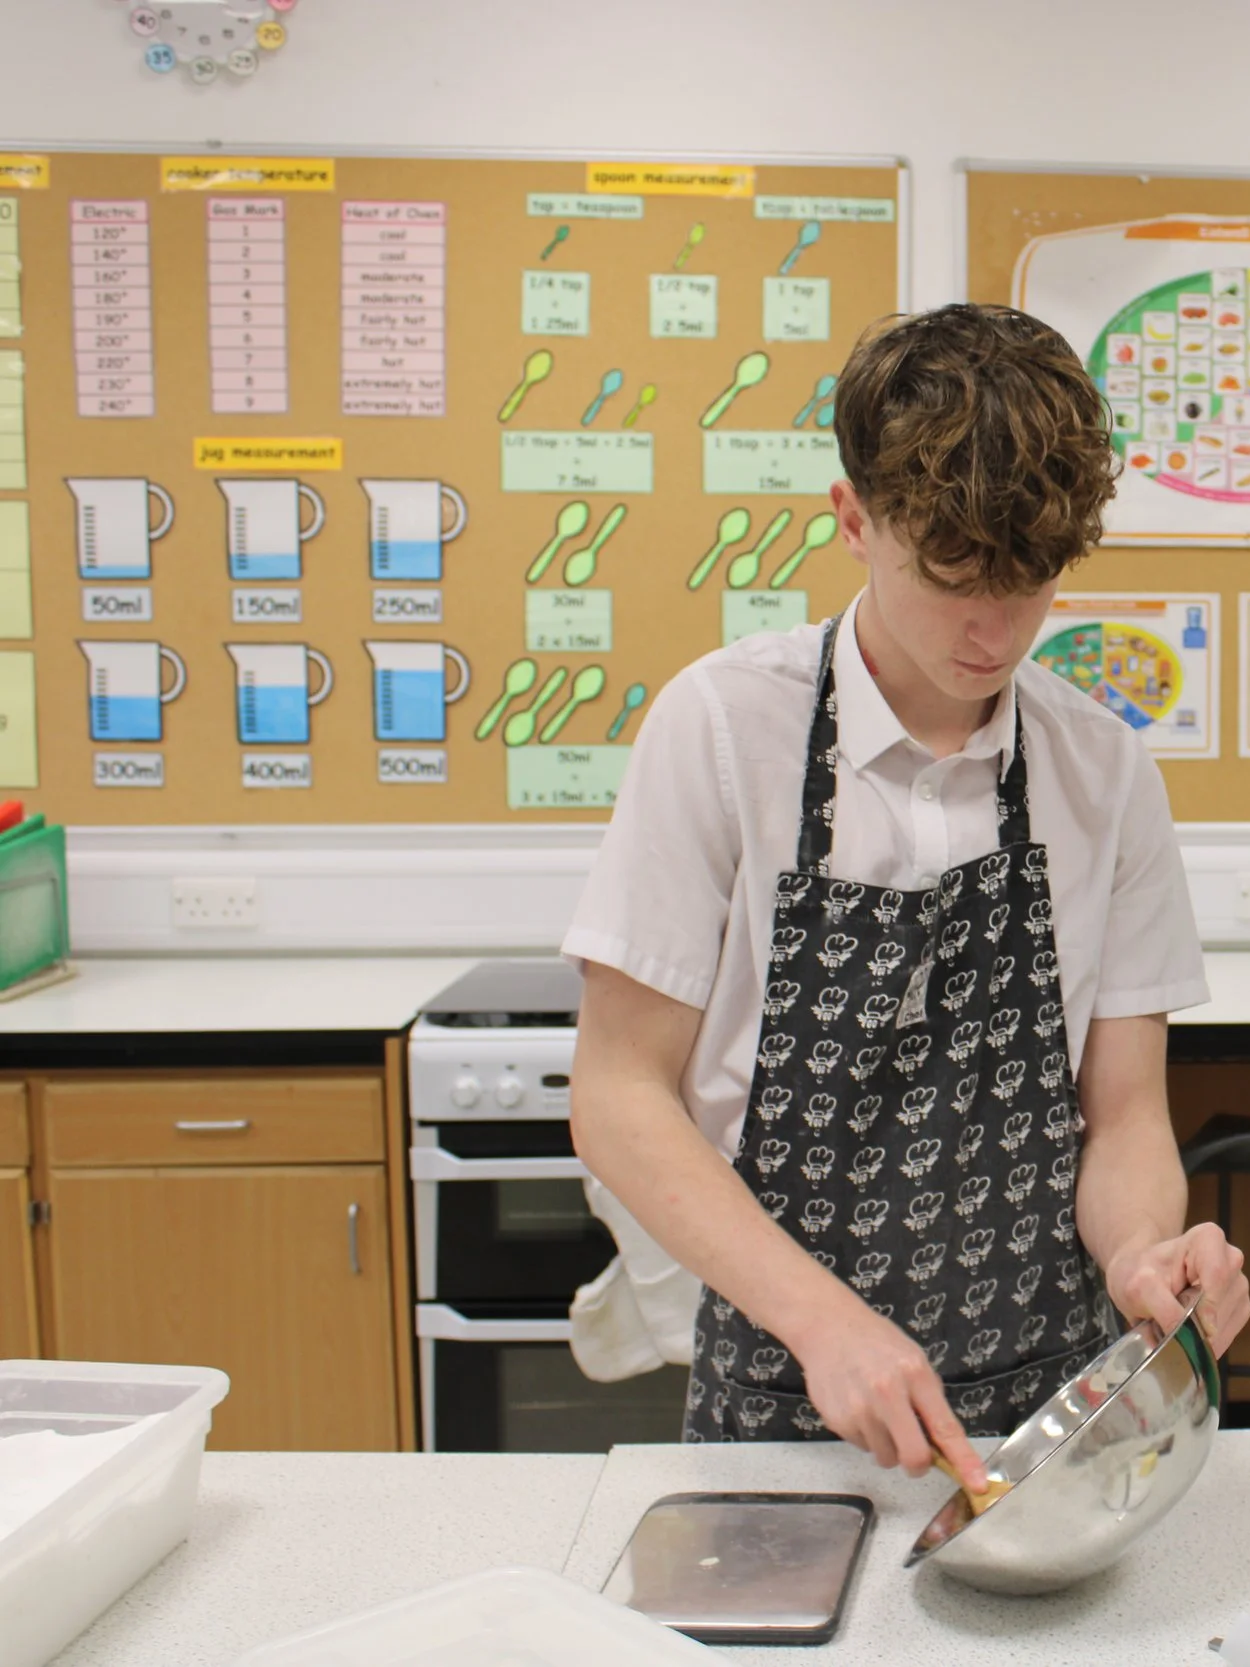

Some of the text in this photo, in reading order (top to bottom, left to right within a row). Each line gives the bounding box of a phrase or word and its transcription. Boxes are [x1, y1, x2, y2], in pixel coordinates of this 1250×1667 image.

[152, 50, 172, 65] 35
[593, 171, 635, 186] spoon
[82, 205, 136, 218] Electric
[199, 444, 336, 463] jug measurement
[92, 594, 142, 615] 50ml
[236, 595, 298, 615] 150ml
[374, 595, 439, 615] 250ml
[97, 760, 162, 780] 300ml
[243, 761, 309, 781] 400ml
[379, 757, 443, 776] 500ml
